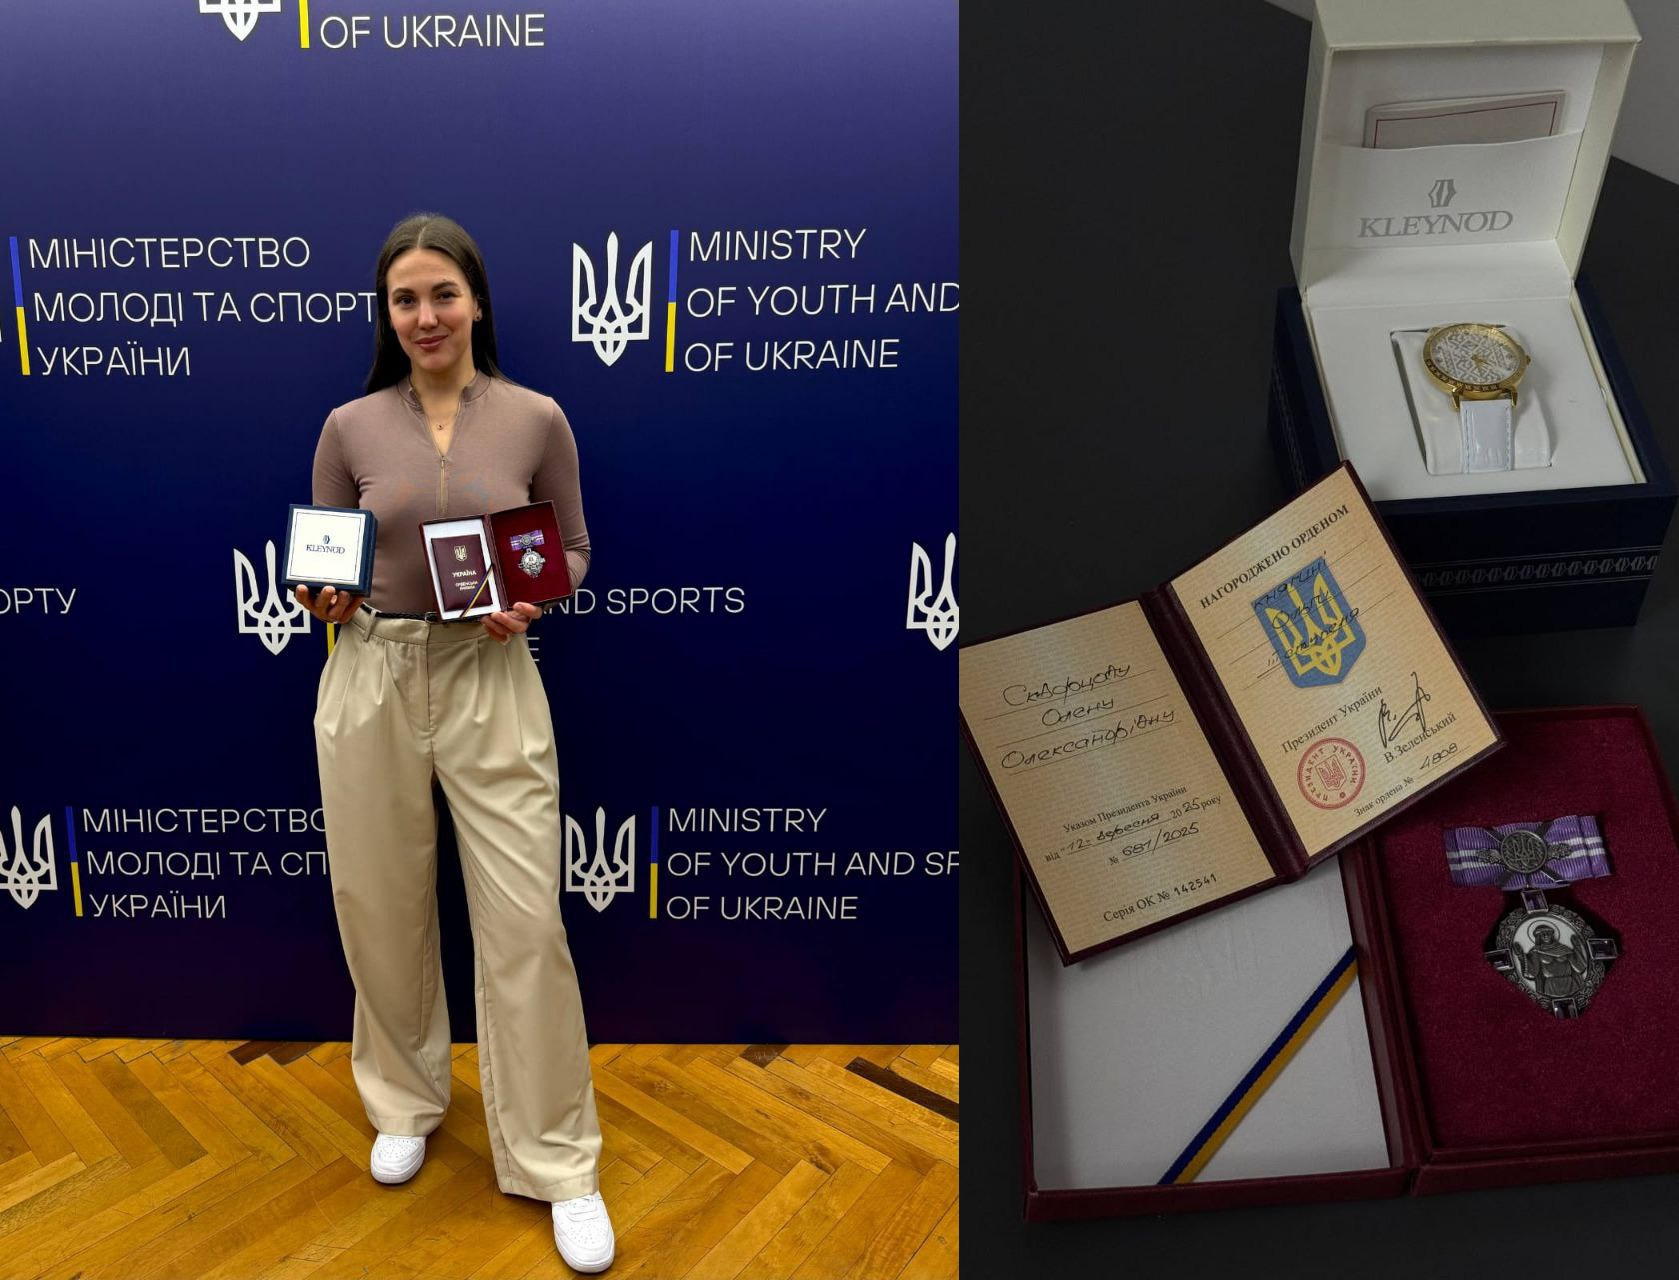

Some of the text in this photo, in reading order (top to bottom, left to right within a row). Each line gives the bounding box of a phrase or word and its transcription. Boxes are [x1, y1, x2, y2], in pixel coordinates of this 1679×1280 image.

[320, 14, 545, 49] OF UKRAINE
[1357, 210, 1514, 239] KLEYNOD
[29, 237, 311, 269] МІНІСТЕРСТВО
[690, 228, 867, 262] MINISTRY
[34, 292, 183, 327] МОЛОДІ
[193, 292, 241, 323] ТА
[687, 282, 959, 318] OF YOUTH AND
[36, 341, 191, 377] УКРАЇНИ
[684, 339, 900, 373] OF UKRAINE
[306, 544, 346, 554] KLEYNOD
[1200, 504, 1349, 609] НАГОРОДЖЕНО ОРДЕНОМ
[606, 587, 745, 614] SPORTS
[1281, 714, 1339, 754] Президент
[1338, 686, 1383, 718] України
[1063, 786, 1187, 833] Указом Президента України
[1353, 802, 1375, 817] Знак
[1375, 784, 1403, 807] ордена
[83, 808, 326, 833] МІНІСТЕРСТВО
[668, 807, 827, 833] MINISTRY
[86, 851, 221, 880] МОЛОДІ
[229, 851, 272, 876] ТА
[667, 851, 712, 877] OF
[720, 851, 836, 877] YOUTH
[845, 851, 915, 876] AND
[1045, 853, 1061, 863] від
[89, 890, 227, 919] УКРАЇНИ
[666, 895, 859, 920] OF UKRAINE
[1103, 904, 1135, 922] Серія
[1136, 896, 1157, 910] ОК
[1173, 873, 1218, 896] 142541
